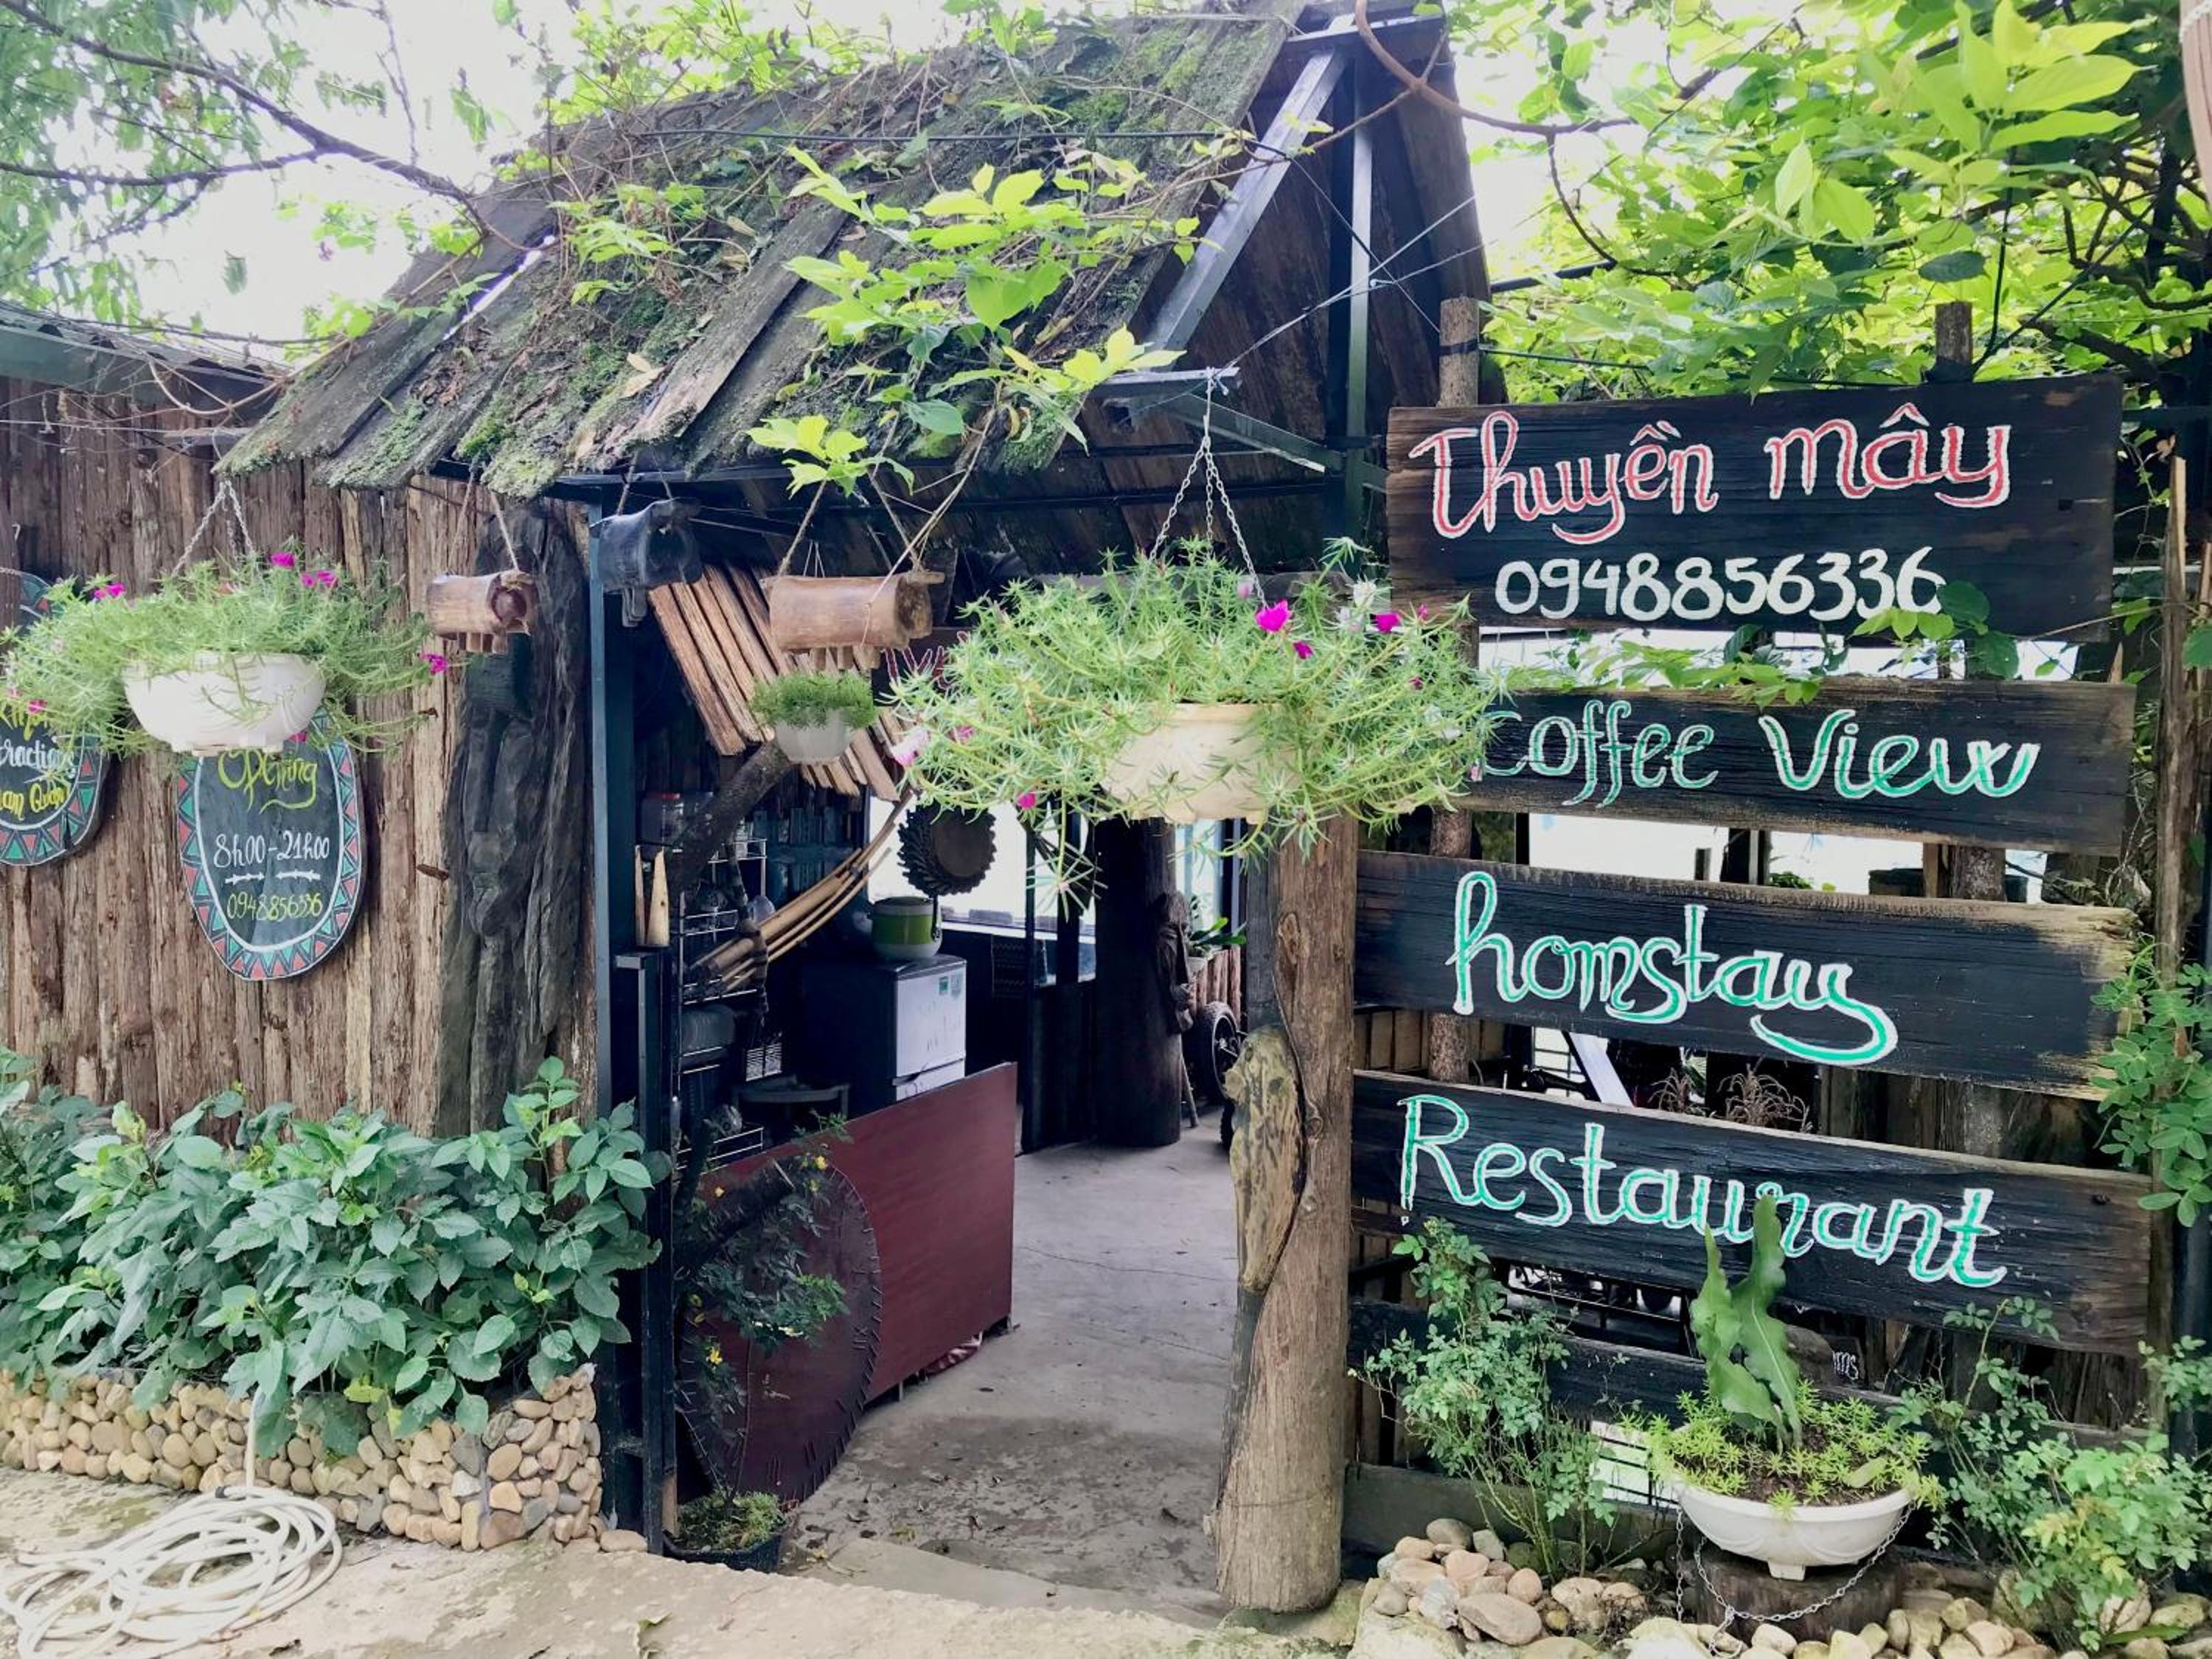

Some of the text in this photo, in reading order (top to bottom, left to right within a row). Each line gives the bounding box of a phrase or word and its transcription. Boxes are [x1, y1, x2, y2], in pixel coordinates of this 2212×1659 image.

[1409, 410, 1718, 545] Thuyền
[1495, 546, 1945, 622] 0948856336
[1758, 709, 2041, 799] View
[226, 892, 323, 922] 0948856336
[1397, 1094, 2007, 1287] Restaurant
